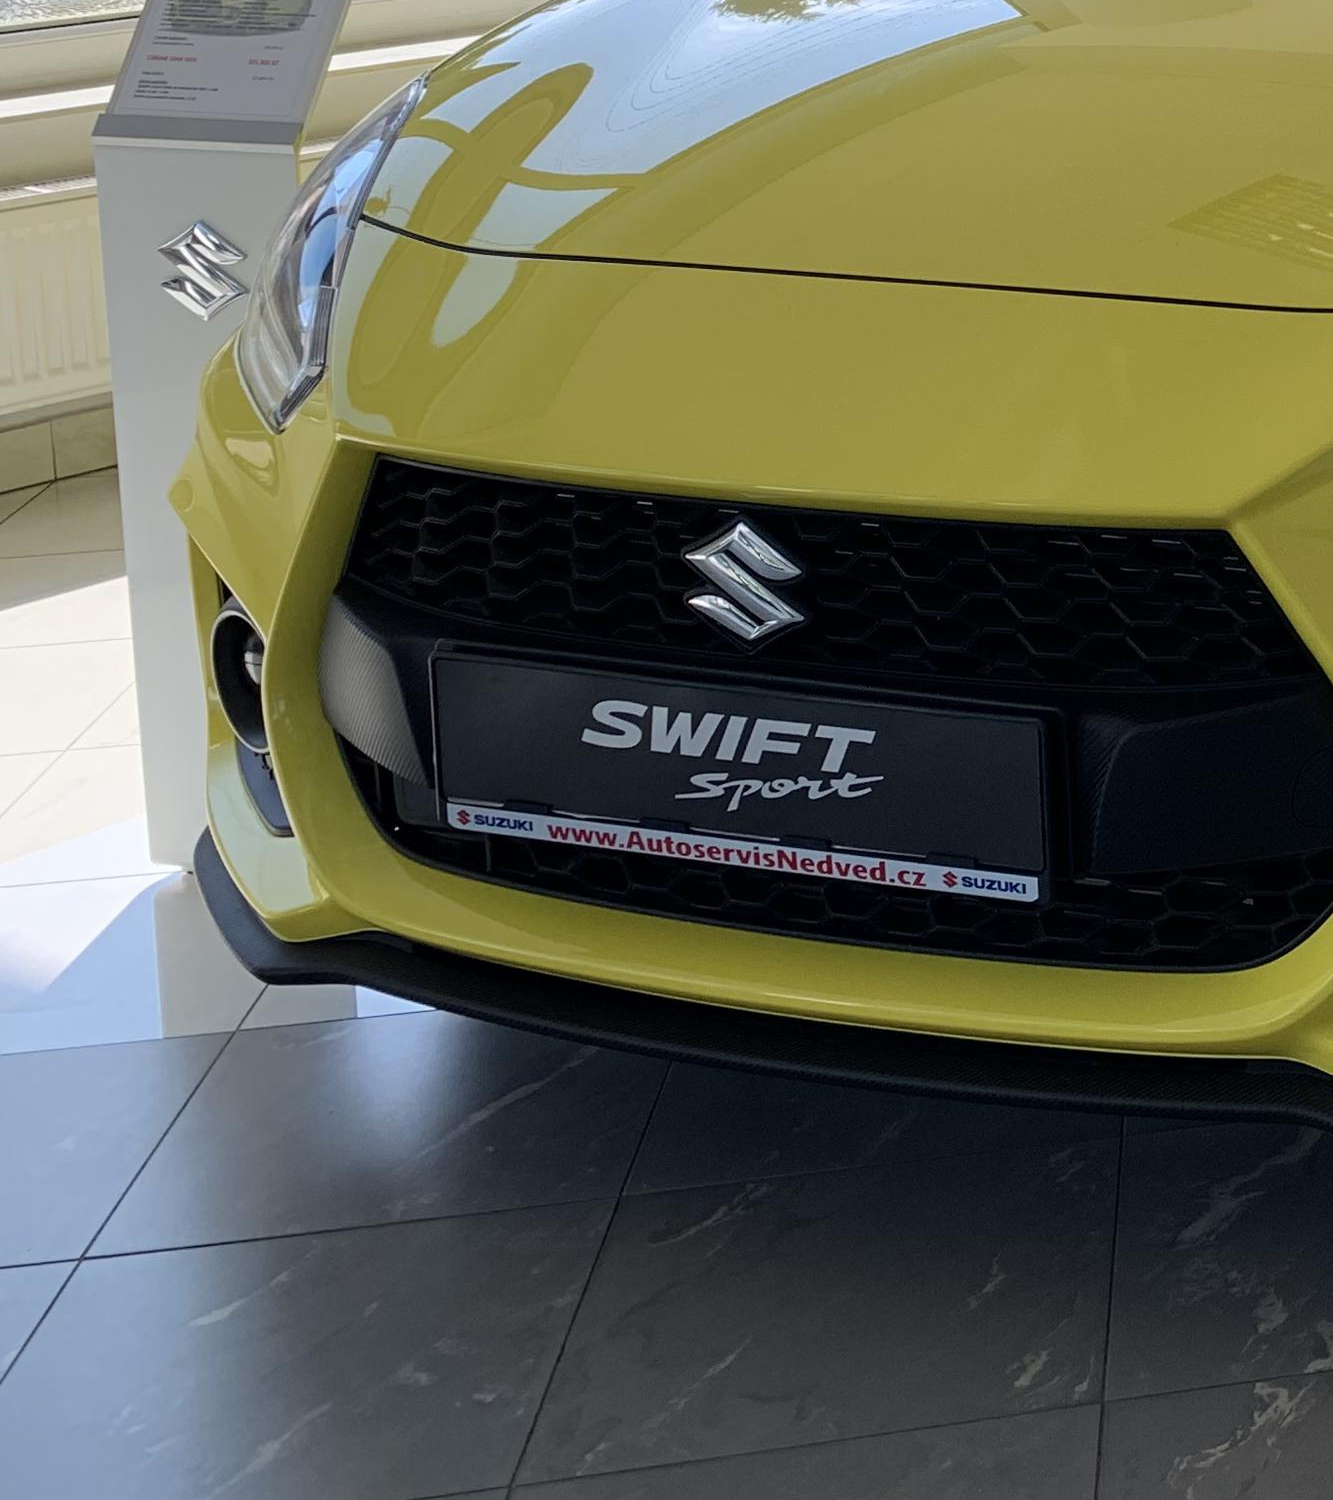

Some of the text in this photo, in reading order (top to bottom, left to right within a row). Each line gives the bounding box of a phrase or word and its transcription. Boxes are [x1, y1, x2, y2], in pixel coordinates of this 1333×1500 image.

[581, 700, 876, 773] SWIFT
[674, 771, 885, 812] Sport
[474, 814, 1027, 895] SUZUKI www.AutoservisNedved.cz SUZUKI
